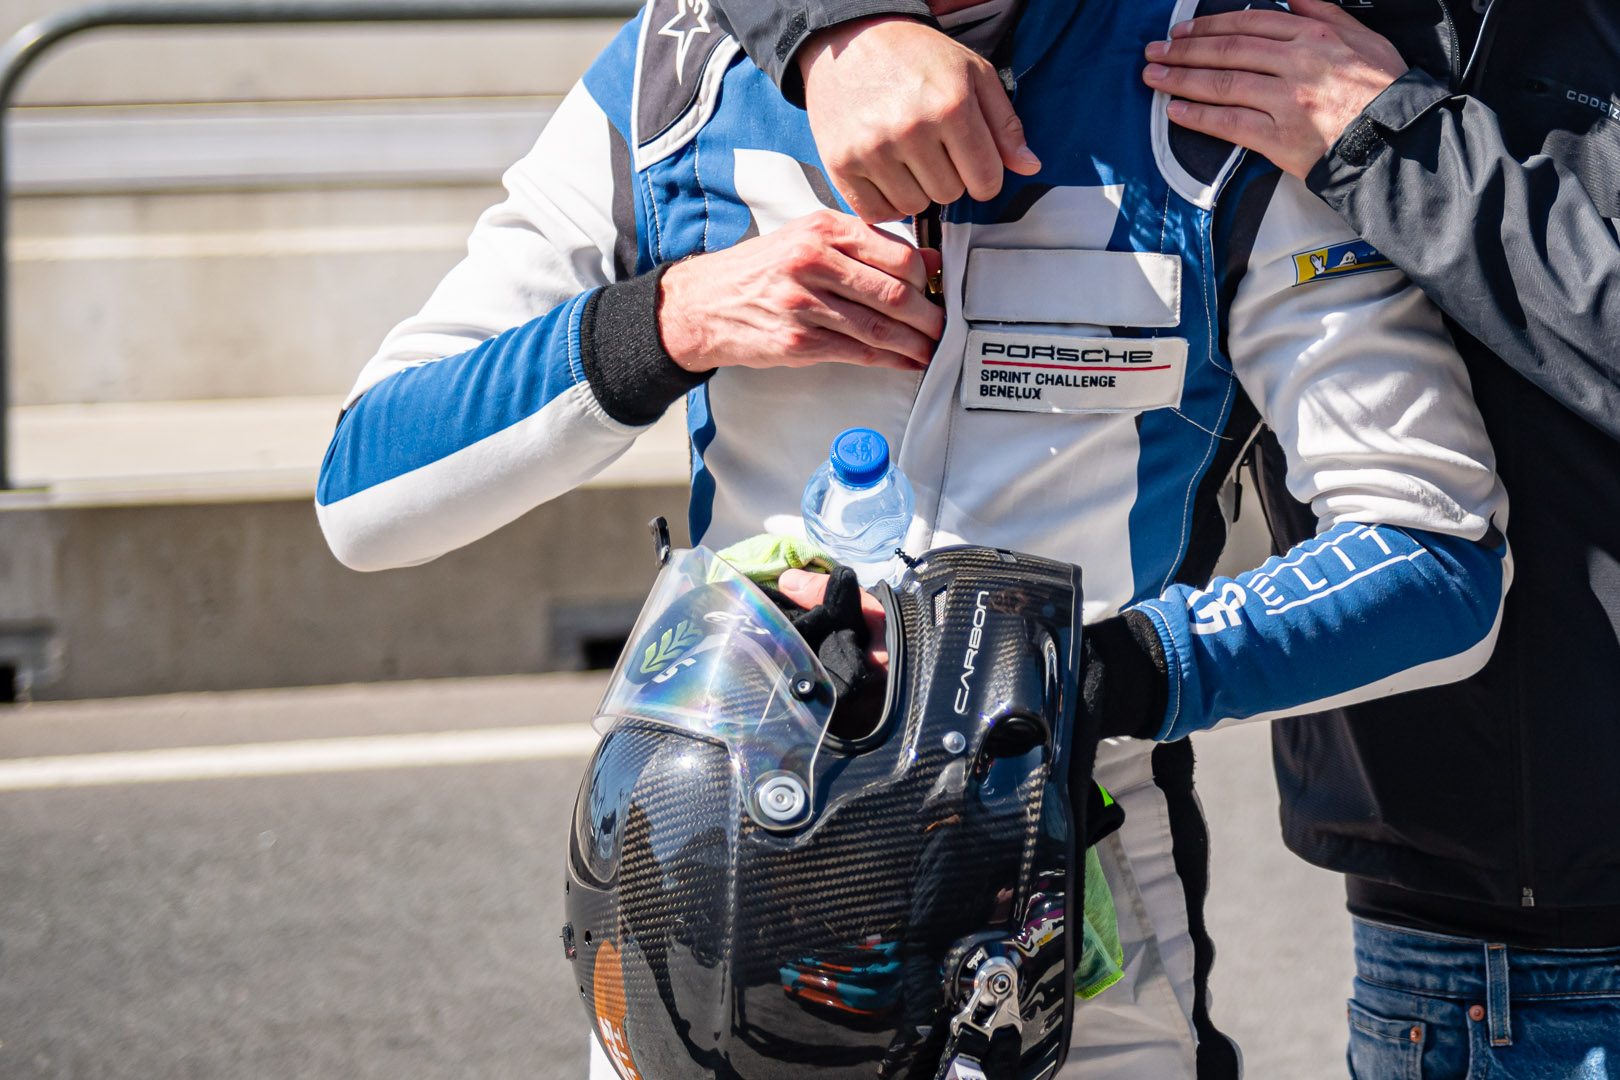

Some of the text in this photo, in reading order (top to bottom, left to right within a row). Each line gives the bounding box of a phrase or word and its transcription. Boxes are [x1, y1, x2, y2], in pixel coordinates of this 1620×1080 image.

[981, 342, 1153, 363] PORSCHE
[980, 369, 1116, 388] SPRINT CHALLENGE
[979, 384, 1042, 400] BENELUX
[954, 591, 989, 713] CARBON
